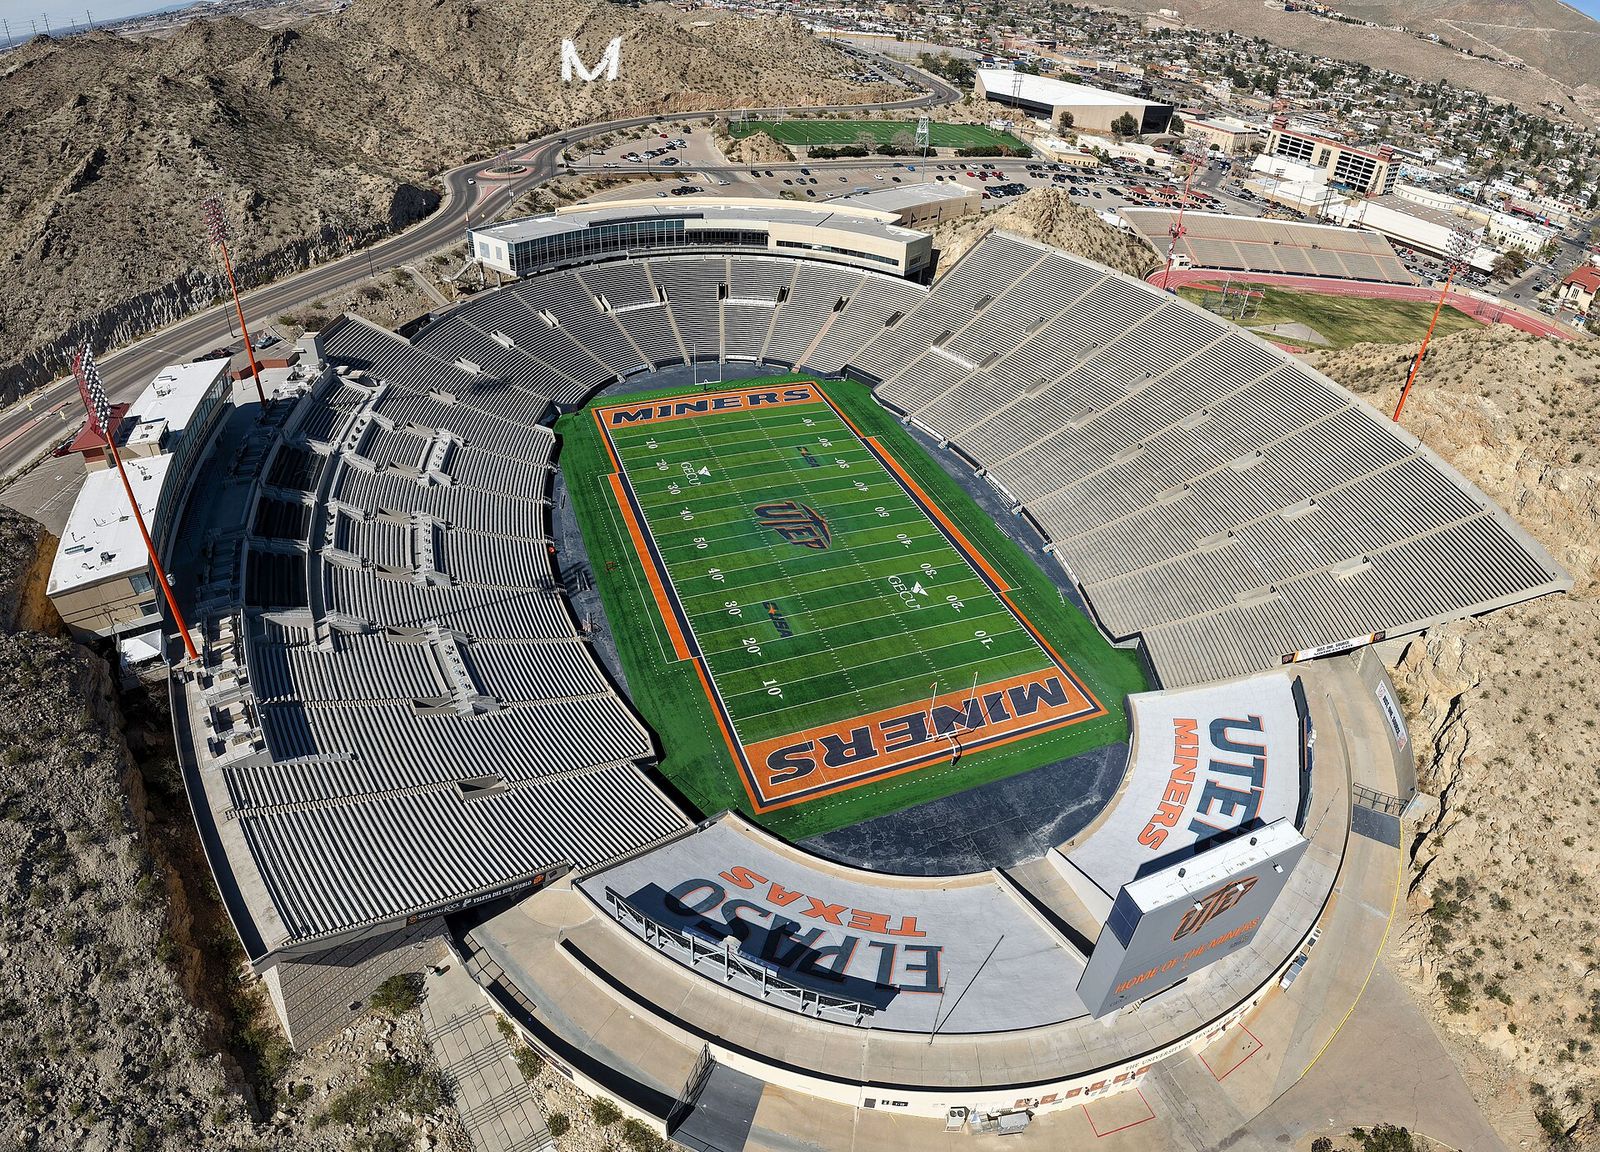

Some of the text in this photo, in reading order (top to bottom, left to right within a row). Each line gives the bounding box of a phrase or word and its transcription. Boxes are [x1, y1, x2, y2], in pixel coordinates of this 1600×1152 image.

[561, 37, 621, 82] M
[612, 388, 812, 425] MINERS
[646, 440, 658, 449] 10
[656, 461, 669, 471] 20
[681, 462, 701, 485] GECU
[668, 484, 681, 495] 30
[680, 510, 694, 520] 40
[875, 507, 890, 517] 50
[754, 500, 831, 550] UTEP
[693, 537, 708, 549] 50
[897, 534, 912, 545] 40
[708, 568, 724, 580] 40
[920, 563, 937, 576] 30
[888, 575, 920, 609] GECU
[725, 600, 741, 615] 30
[946, 595, 965, 609] 20
[742, 637, 760, 653] 20
[974, 630, 994, 646] 10
[763, 678, 782, 696] 10
[766, 677, 1070, 786] MINERS
[1136, 718, 1198, 851] MINERS
[719, 865, 926, 937] TEXAS
[1172, 876, 1259, 942] UTEP
[664, 878, 944, 994] EL PASO
[1114, 968, 1158, 994] HOME
